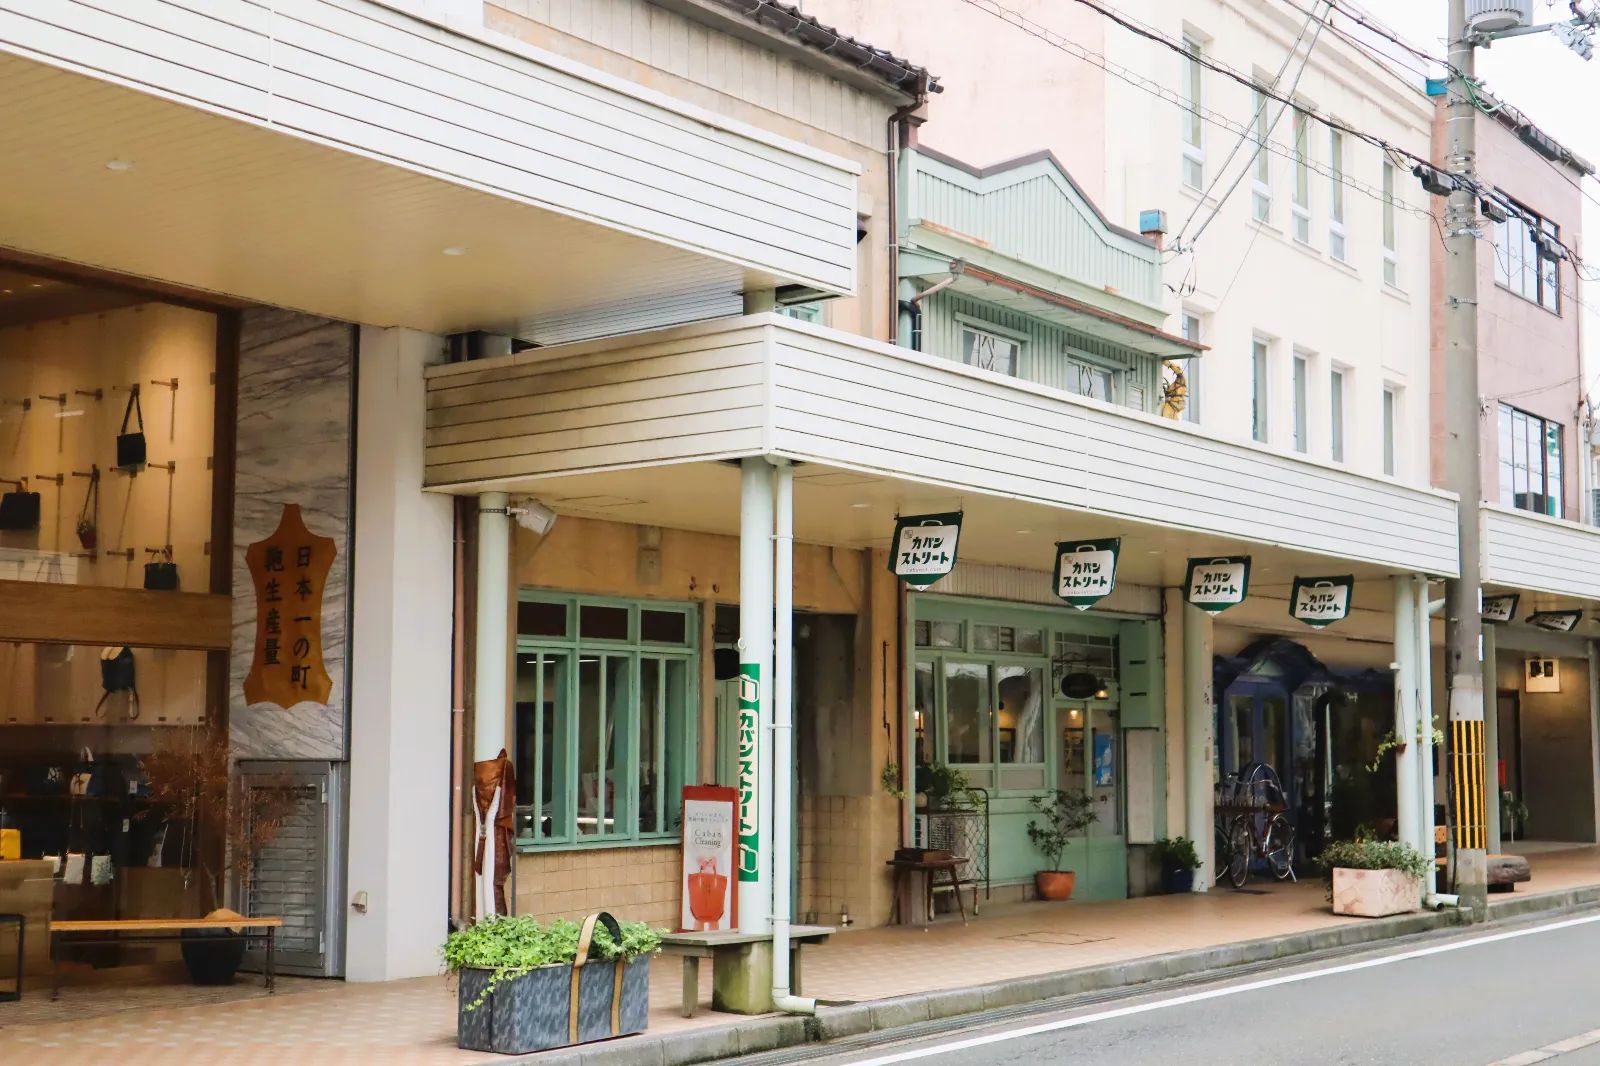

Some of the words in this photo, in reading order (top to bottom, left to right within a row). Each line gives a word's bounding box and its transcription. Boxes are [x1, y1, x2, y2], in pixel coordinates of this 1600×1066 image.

[912, 536, 944, 550] カバン
[901, 552, 949, 565] ストリート
[1073, 562, 1101, 574] カバン
[1063, 576, 1107, 588] ストリート
[1203, 572, 1231, 583] カバン
[1193, 584, 1238, 595] ストリート
[1309, 593, 1335, 603] カバン
[263, 546, 285, 665] 鞄生産量
[1300, 603, 1341, 613] ストリート
[290, 545, 313, 690] 日本一の町
[739, 712, 754, 833] カバンストリート
[694, 829, 722, 837] Caban
[694, 837, 722, 849] Cleaning
